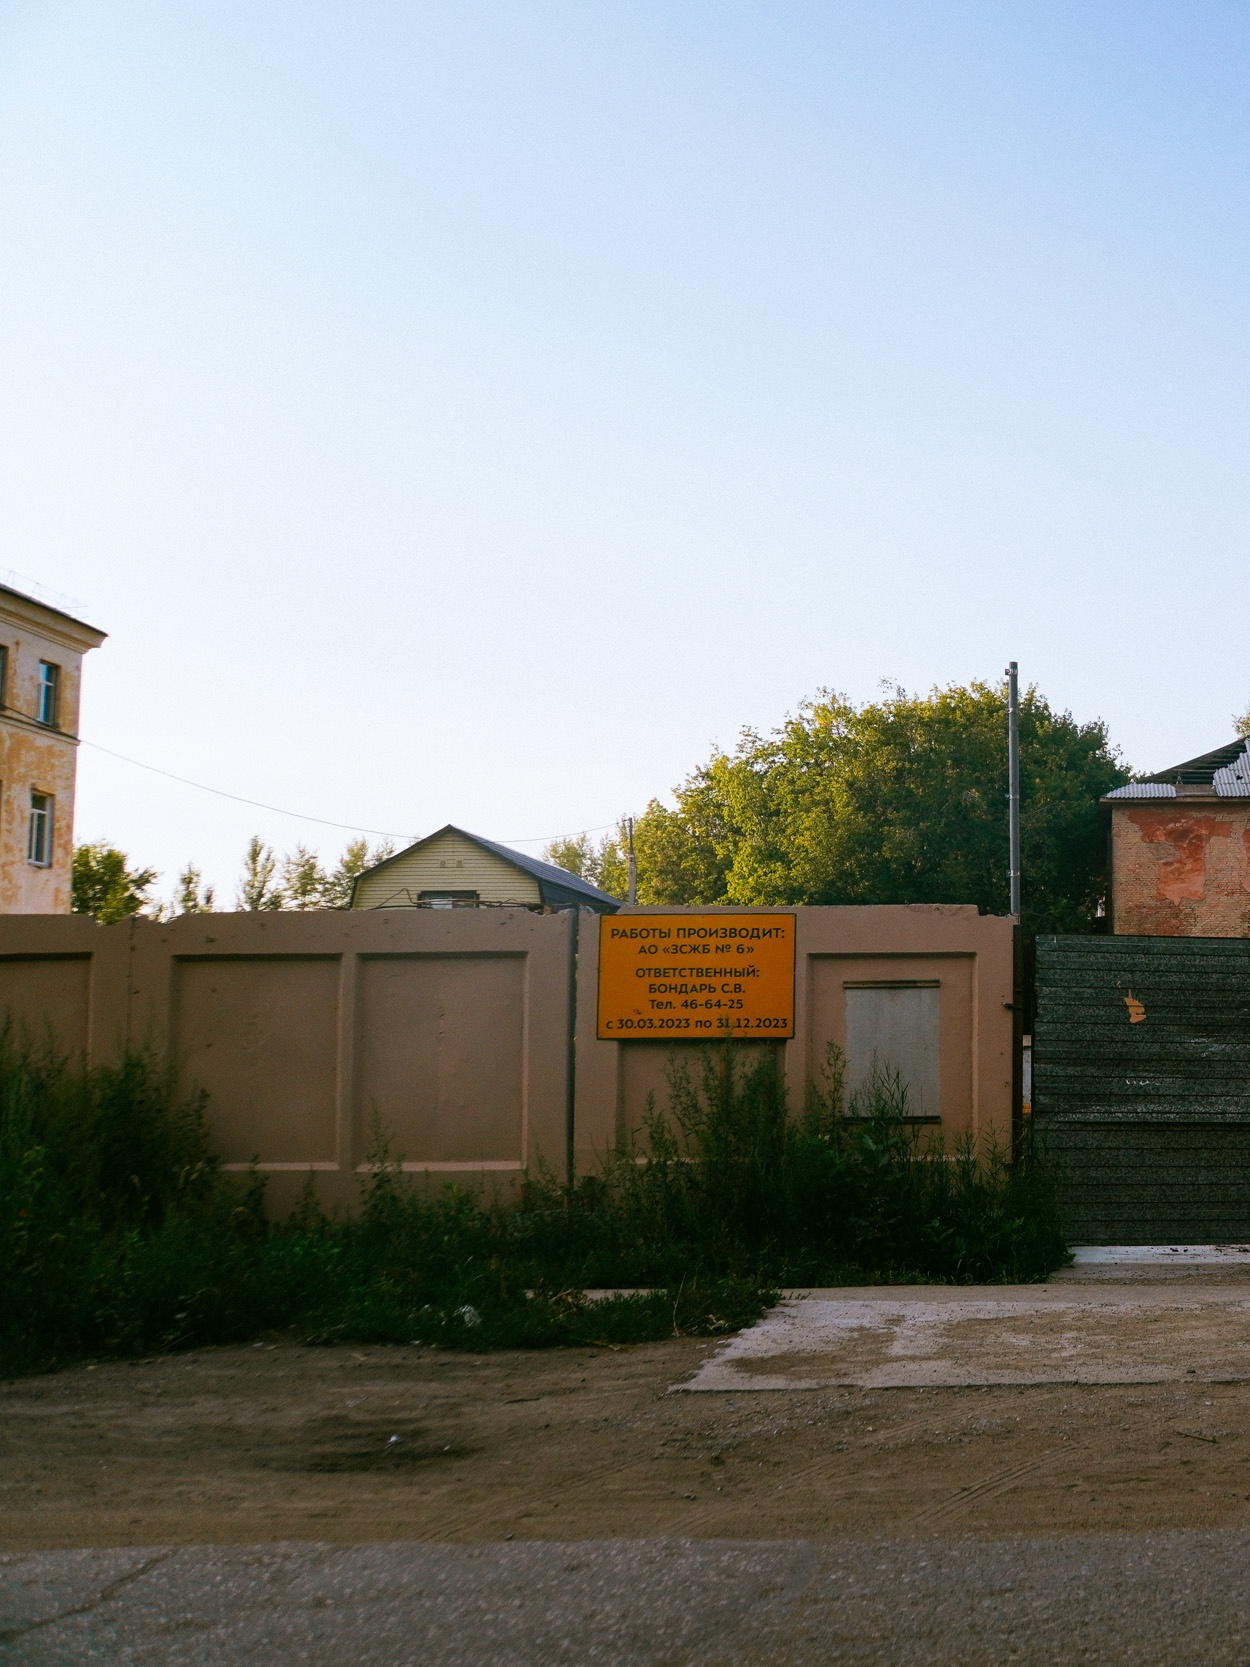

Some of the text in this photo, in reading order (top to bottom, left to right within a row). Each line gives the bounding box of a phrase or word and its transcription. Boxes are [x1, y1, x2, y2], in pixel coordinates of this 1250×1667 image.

[611, 927, 785, 940] РАБОТЫ ПРОИЗВОДИТ:
[638, 944, 755, 955] АО «ЗСЖБ № 6»
[635, 965, 760, 978] ОТВЕТСТВЕННЫЙ:
[648, 984, 746, 995] БОНДАРЬ С.В.
[649, 1000, 744, 1010] Тел. 46-64-25
[606, 1018, 788, 1030] с 30.03.2023 по 3112.2023
